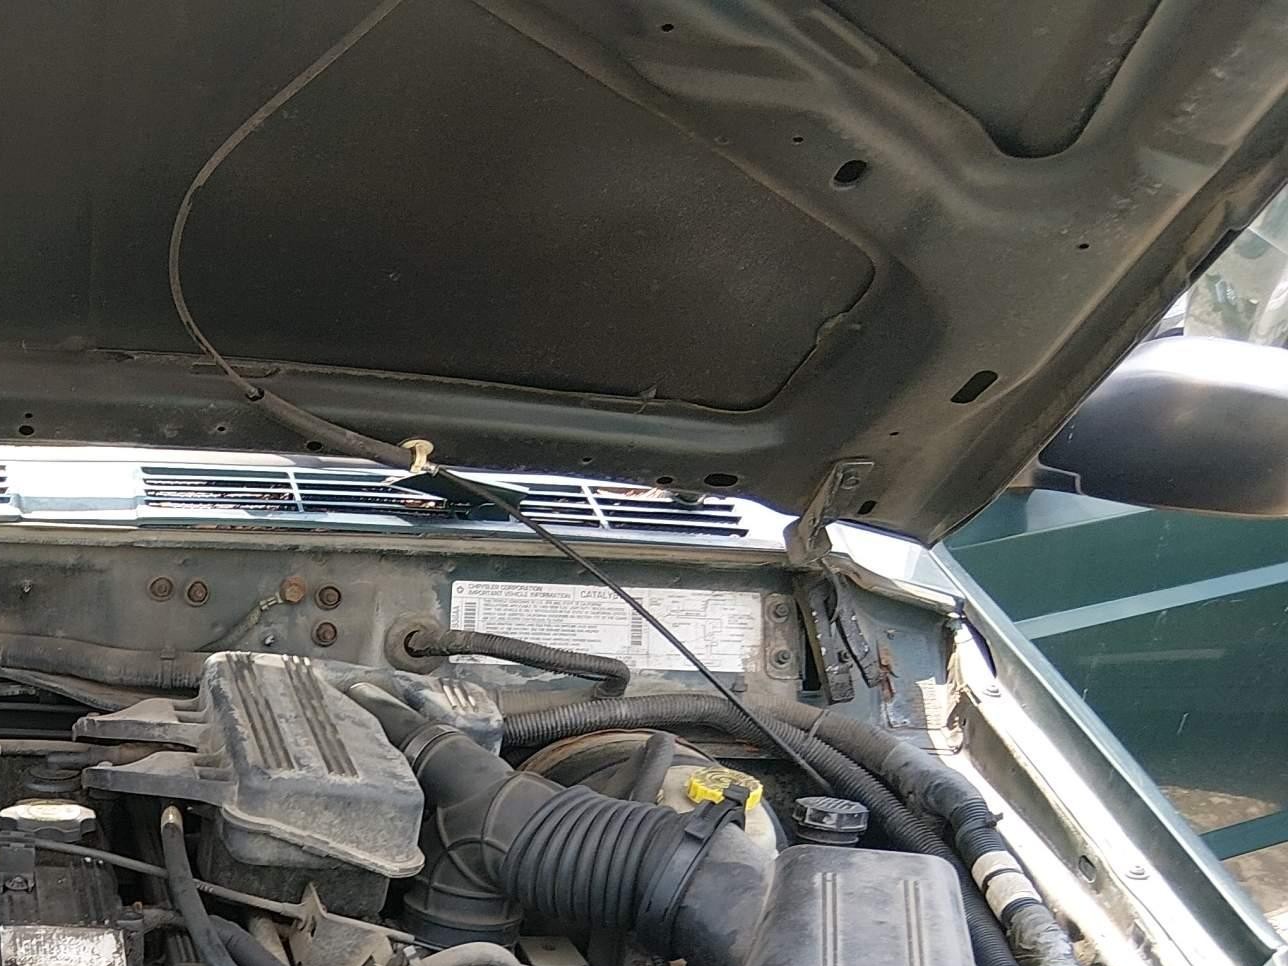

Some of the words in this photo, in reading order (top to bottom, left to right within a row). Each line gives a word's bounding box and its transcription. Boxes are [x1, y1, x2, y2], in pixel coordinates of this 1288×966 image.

[500, 584, 543, 592] CORPORATION
[468, 589, 503, 597] IMPORTANT
[504, 590, 529, 598] VEHICLE
[530, 591, 571, 599] INFORMATION
[580, 590, 619, 600] CATALYS
